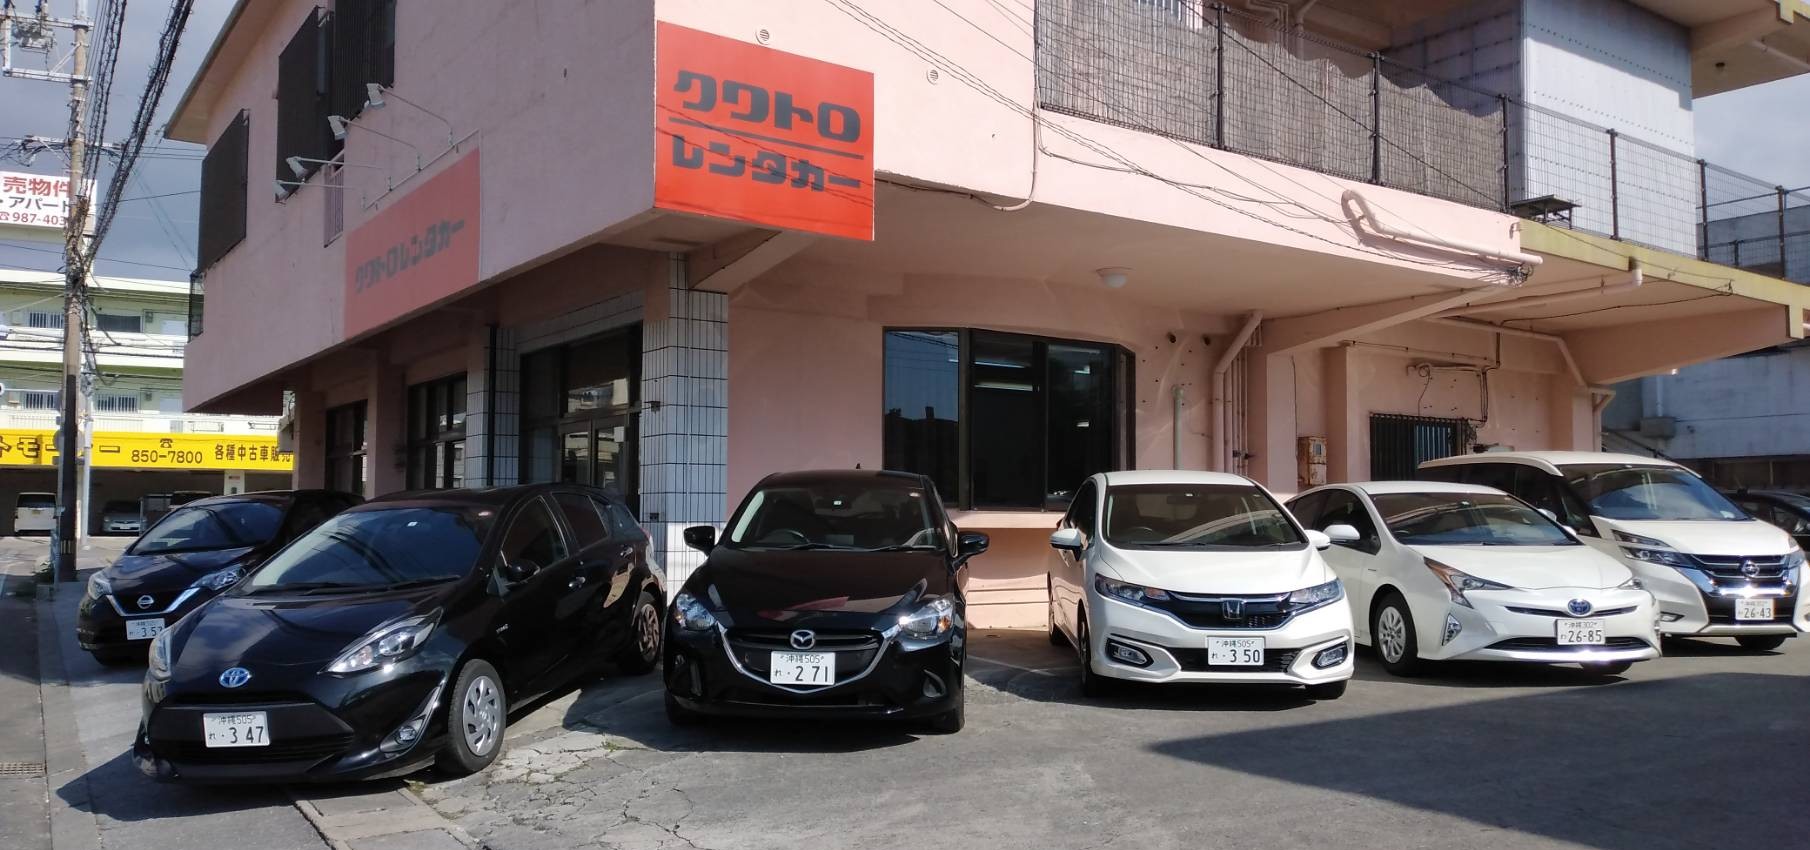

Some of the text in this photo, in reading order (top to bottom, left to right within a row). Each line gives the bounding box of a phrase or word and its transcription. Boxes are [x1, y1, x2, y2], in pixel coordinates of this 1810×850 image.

[673, 70, 861, 143] クワトロ
[672, 135, 861, 192] レンタカー
[12, 211, 67, 226] 987-403
[131, 449, 203, 464] 850-7800
[1568, 630, 1602, 643] 26-85
